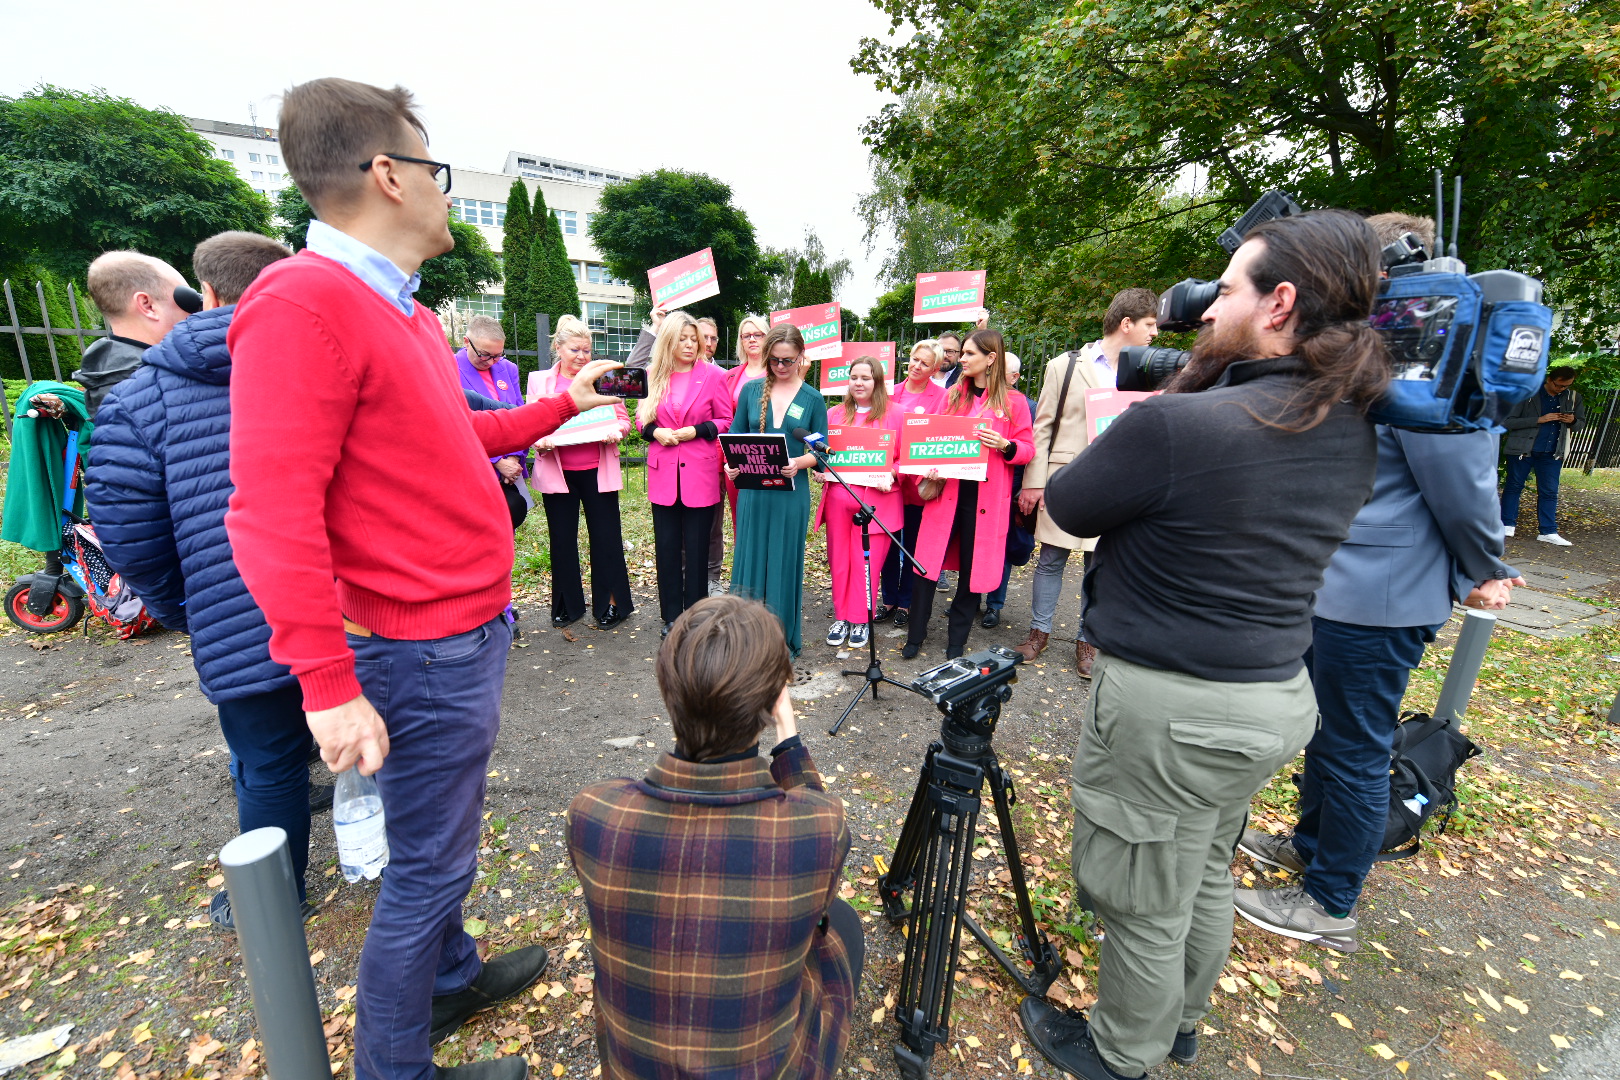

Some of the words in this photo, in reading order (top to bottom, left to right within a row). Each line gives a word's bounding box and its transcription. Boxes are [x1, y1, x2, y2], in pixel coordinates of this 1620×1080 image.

[657, 266, 712, 300] MAJEWSKI
[922, 290, 977, 308] DYLEWICZ
[729, 443, 780, 455] MOSTY!
[910, 442, 980, 456] TRZECIAK
[746, 454, 768, 465] NIE
[827, 452, 884, 464] MAJERYK
[738, 464, 780, 474] MURY!
